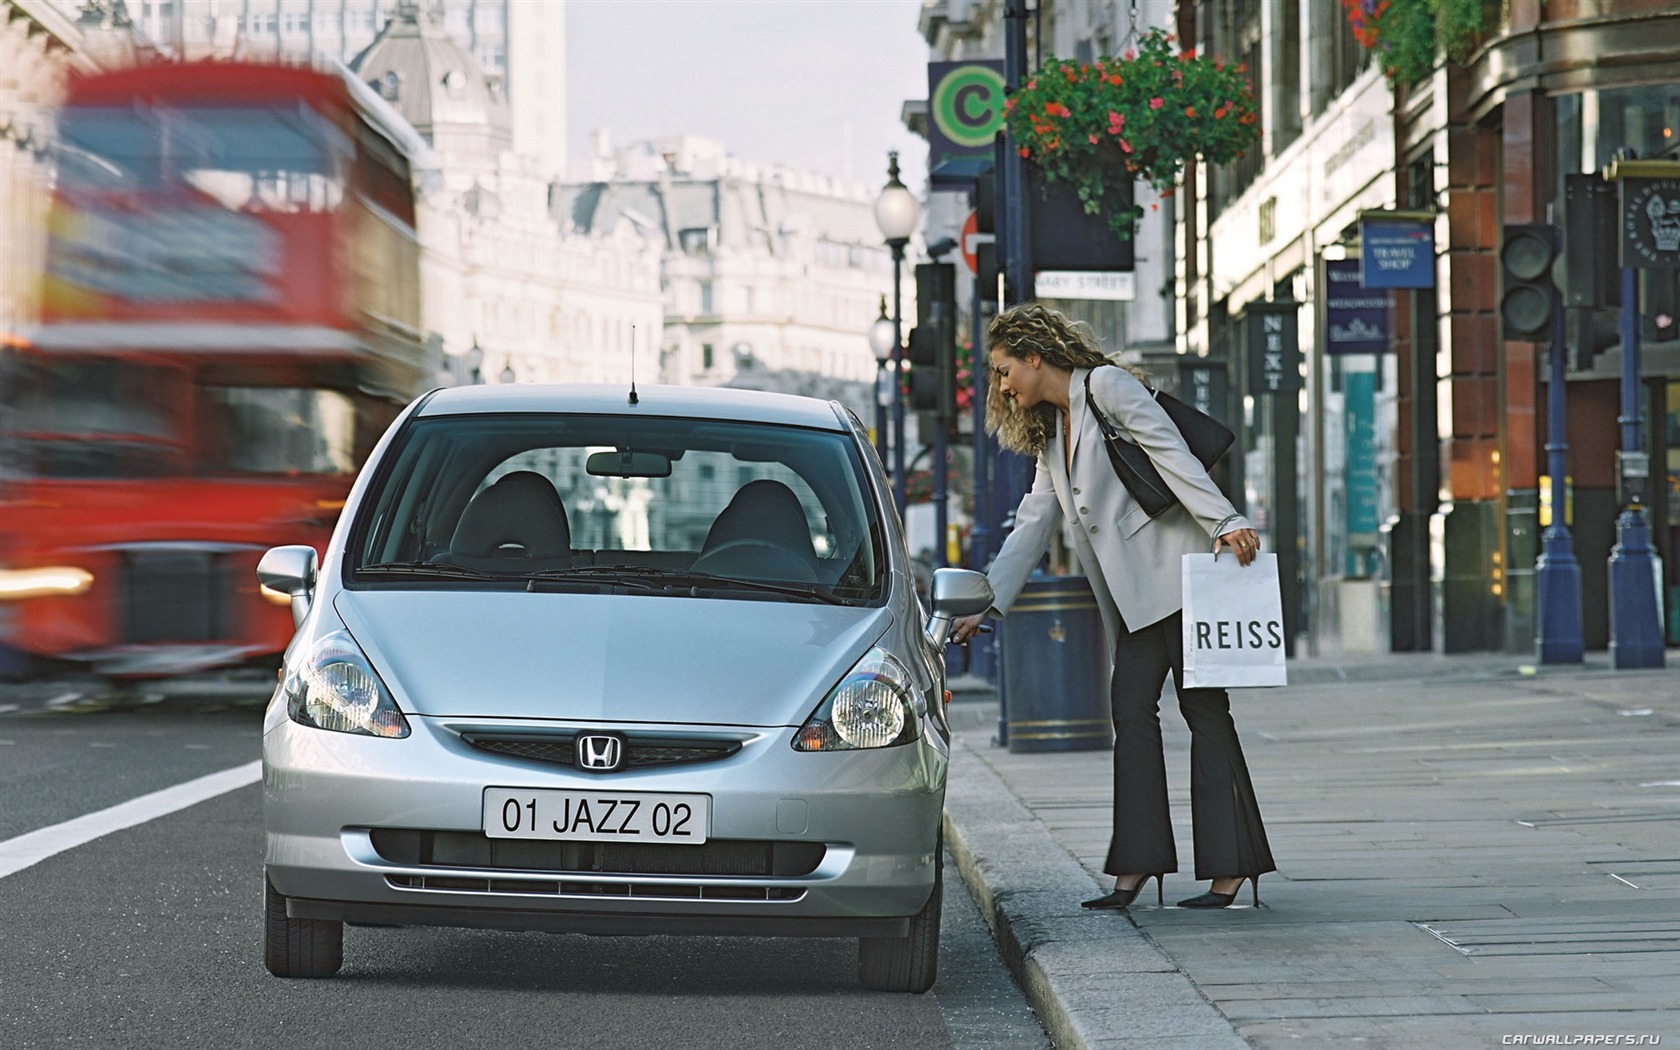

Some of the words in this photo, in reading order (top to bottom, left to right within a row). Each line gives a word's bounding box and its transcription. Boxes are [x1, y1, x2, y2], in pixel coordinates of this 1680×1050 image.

[1263, 315, 1283, 390] NEXT
[1196, 620, 1282, 650] REISS
[502, 798, 537, 832] 01
[552, 798, 641, 834] JAZZ
[651, 802, 692, 836] 02
